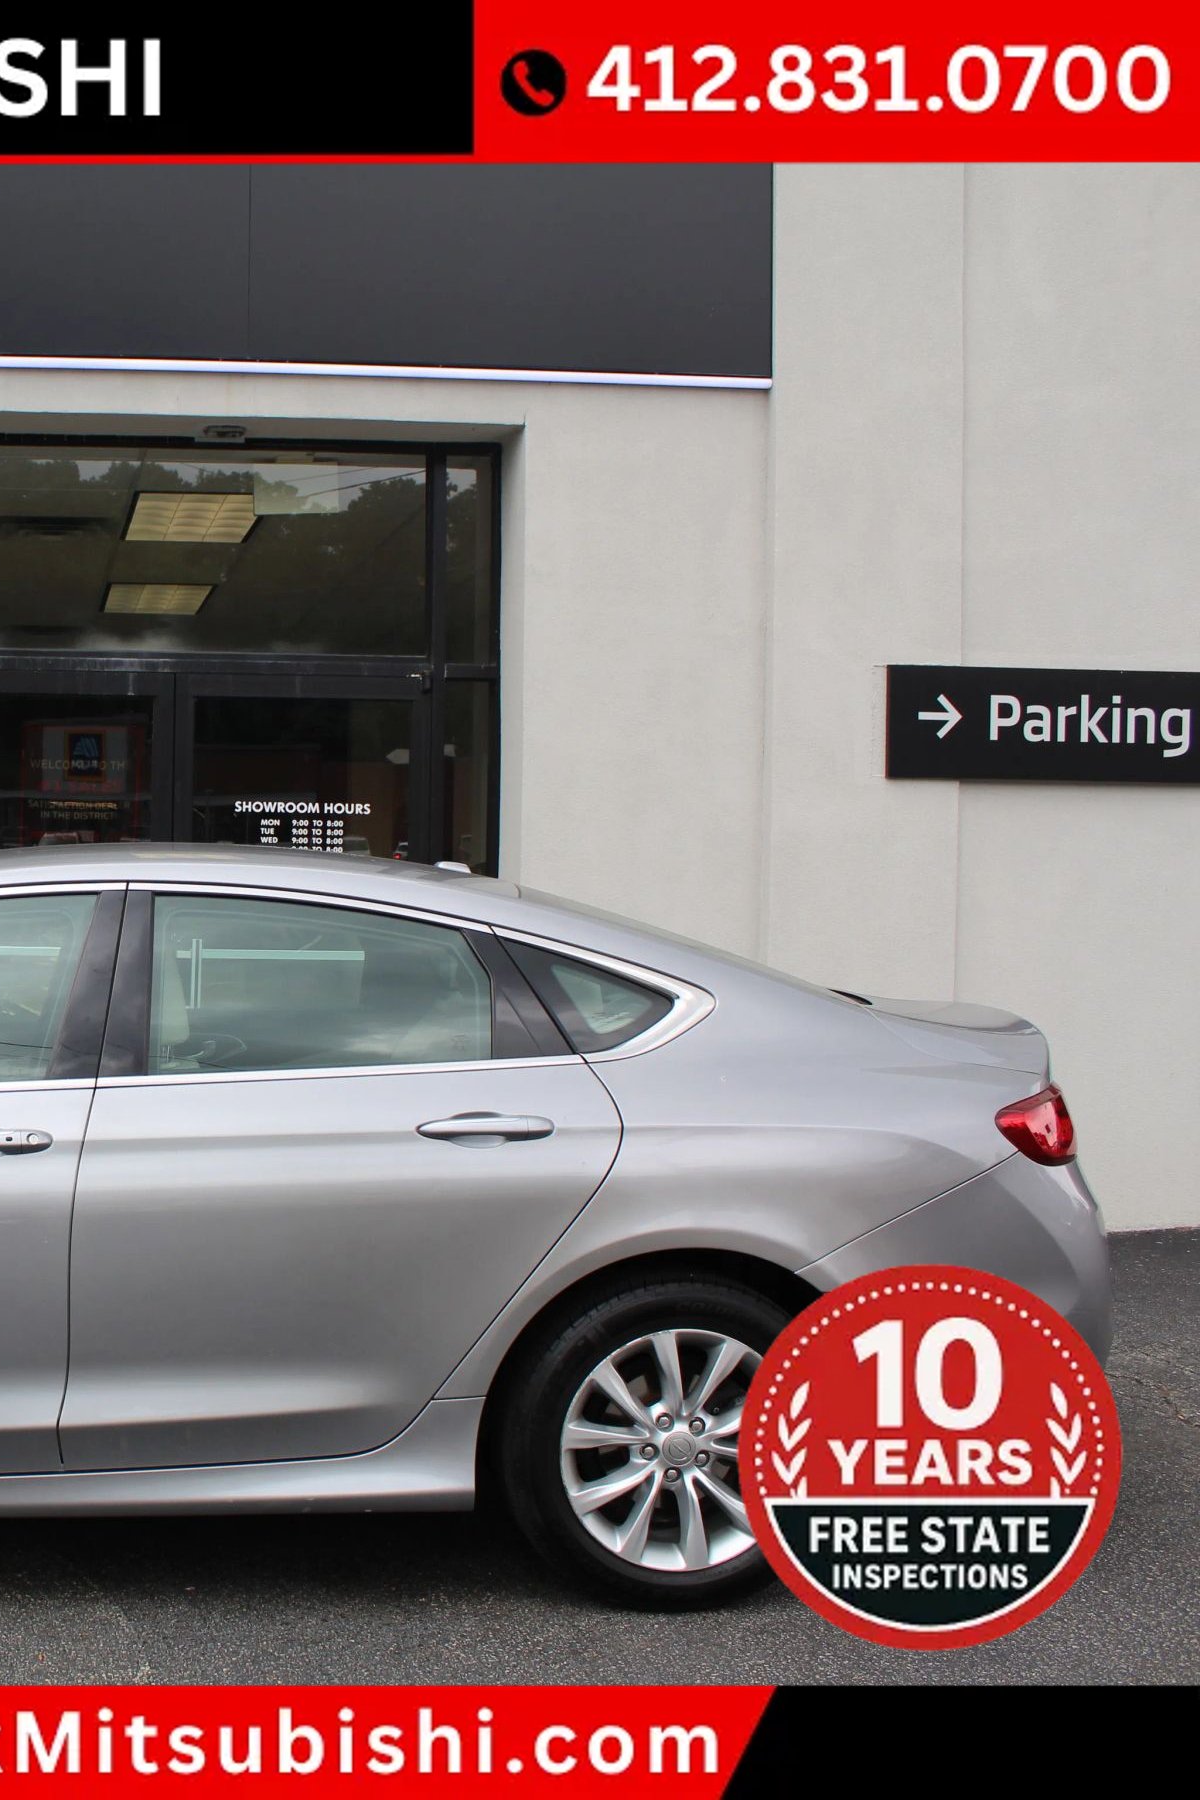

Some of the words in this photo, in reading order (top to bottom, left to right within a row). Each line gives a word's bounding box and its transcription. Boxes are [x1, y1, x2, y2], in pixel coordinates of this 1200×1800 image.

[989, 694, 1191, 758] Parking
[234, 801, 320, 814] SHOWROOM
[324, 803, 371, 815] HOURS
[40, 811, 51, 819] IN
[53, 811, 71, 819] THE
[291, 819, 309, 827] 9:00
[326, 820, 344, 828] 8:00
[260, 827, 275, 835] TUE
[291, 828, 308, 836] 9:00
[312, 828, 322, 836] TO
[312, 837, 322, 845] TO
[326, 837, 343, 845] 8:00
